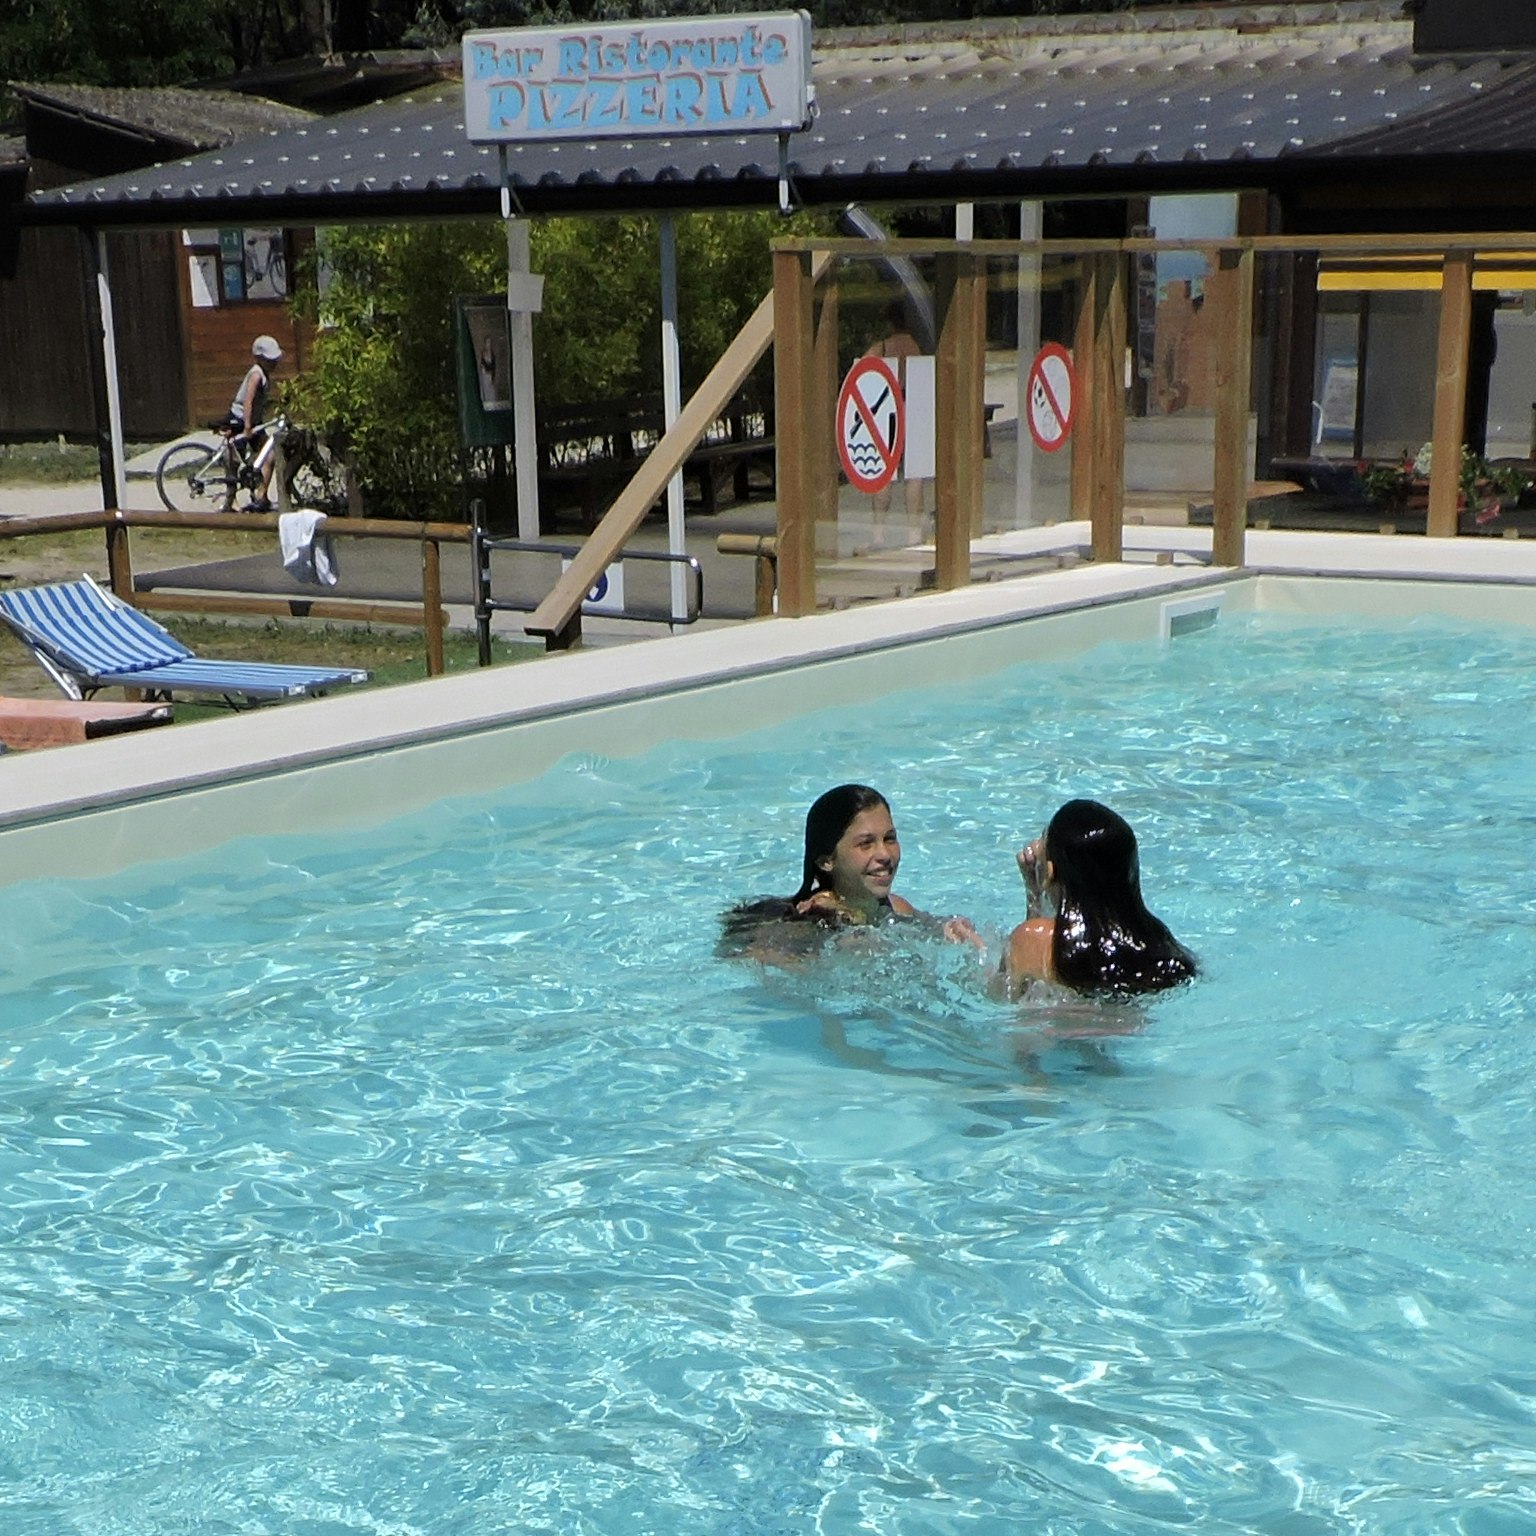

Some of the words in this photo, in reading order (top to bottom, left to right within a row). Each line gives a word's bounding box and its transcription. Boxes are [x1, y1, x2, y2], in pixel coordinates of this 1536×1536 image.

[473, 40, 544, 79] Bar
[560, 25, 788, 76] Ristorante
[487, 68, 775, 130] PIZZERIA
